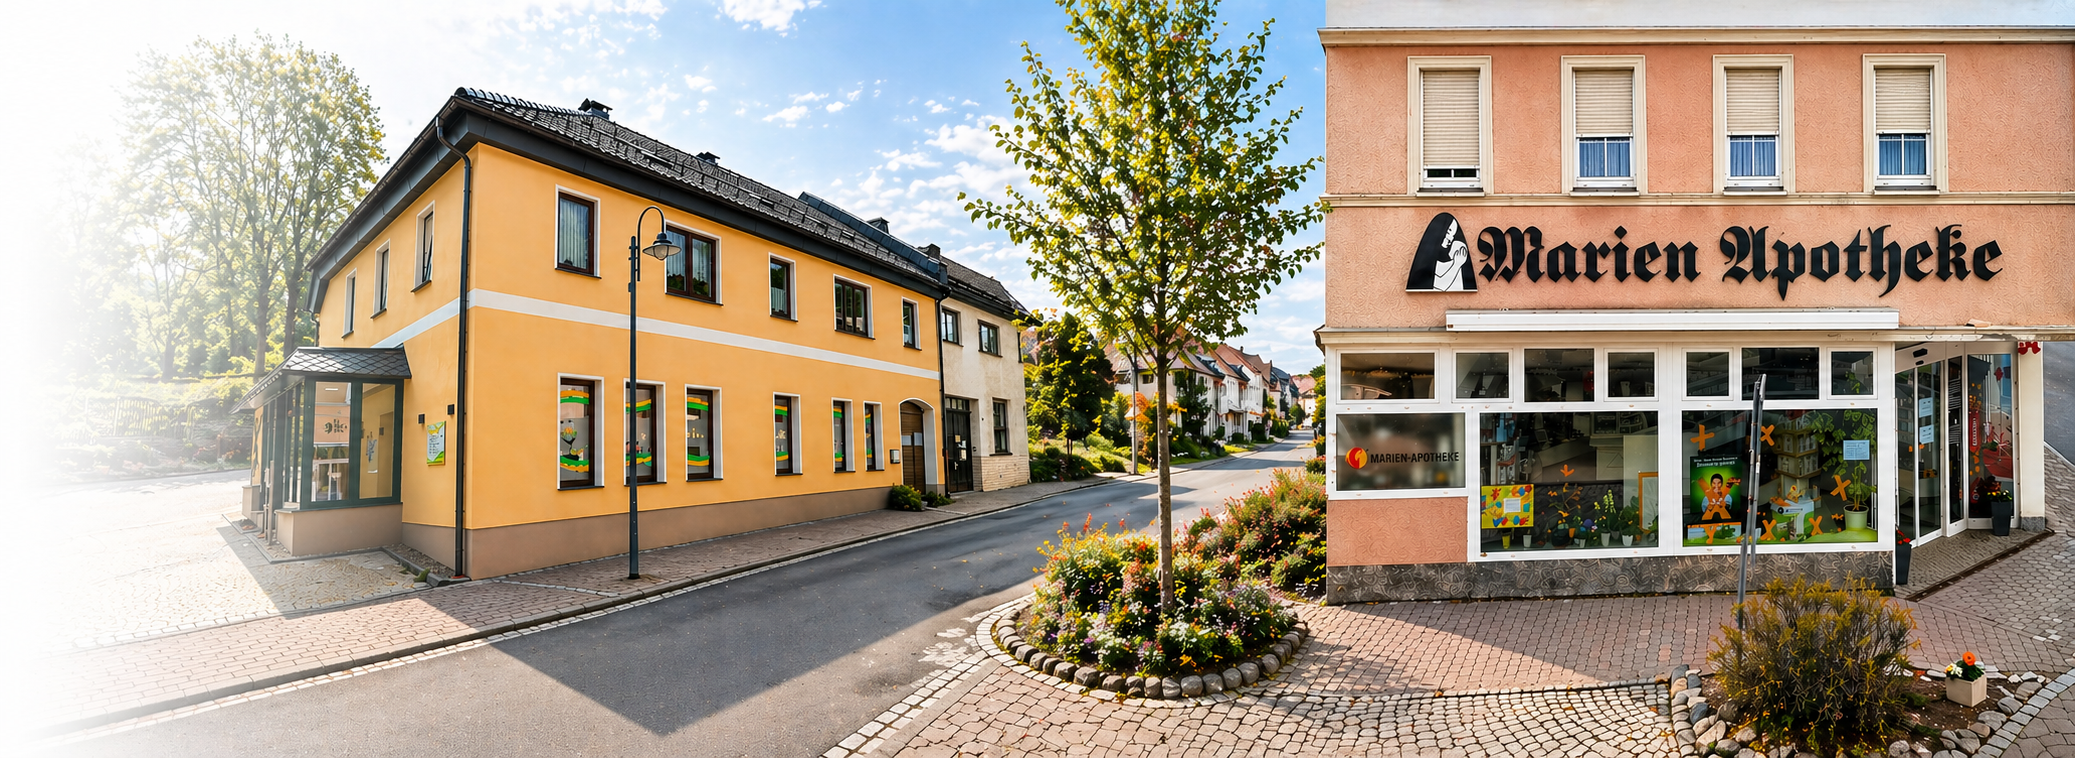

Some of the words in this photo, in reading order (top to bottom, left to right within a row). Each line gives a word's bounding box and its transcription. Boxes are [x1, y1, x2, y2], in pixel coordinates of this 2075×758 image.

[1477, 225, 1702, 284] Marien
[1719, 223, 2004, 301] Apotheke
[1370, 451, 1460, 464] MARIEN-APOTHEKE
